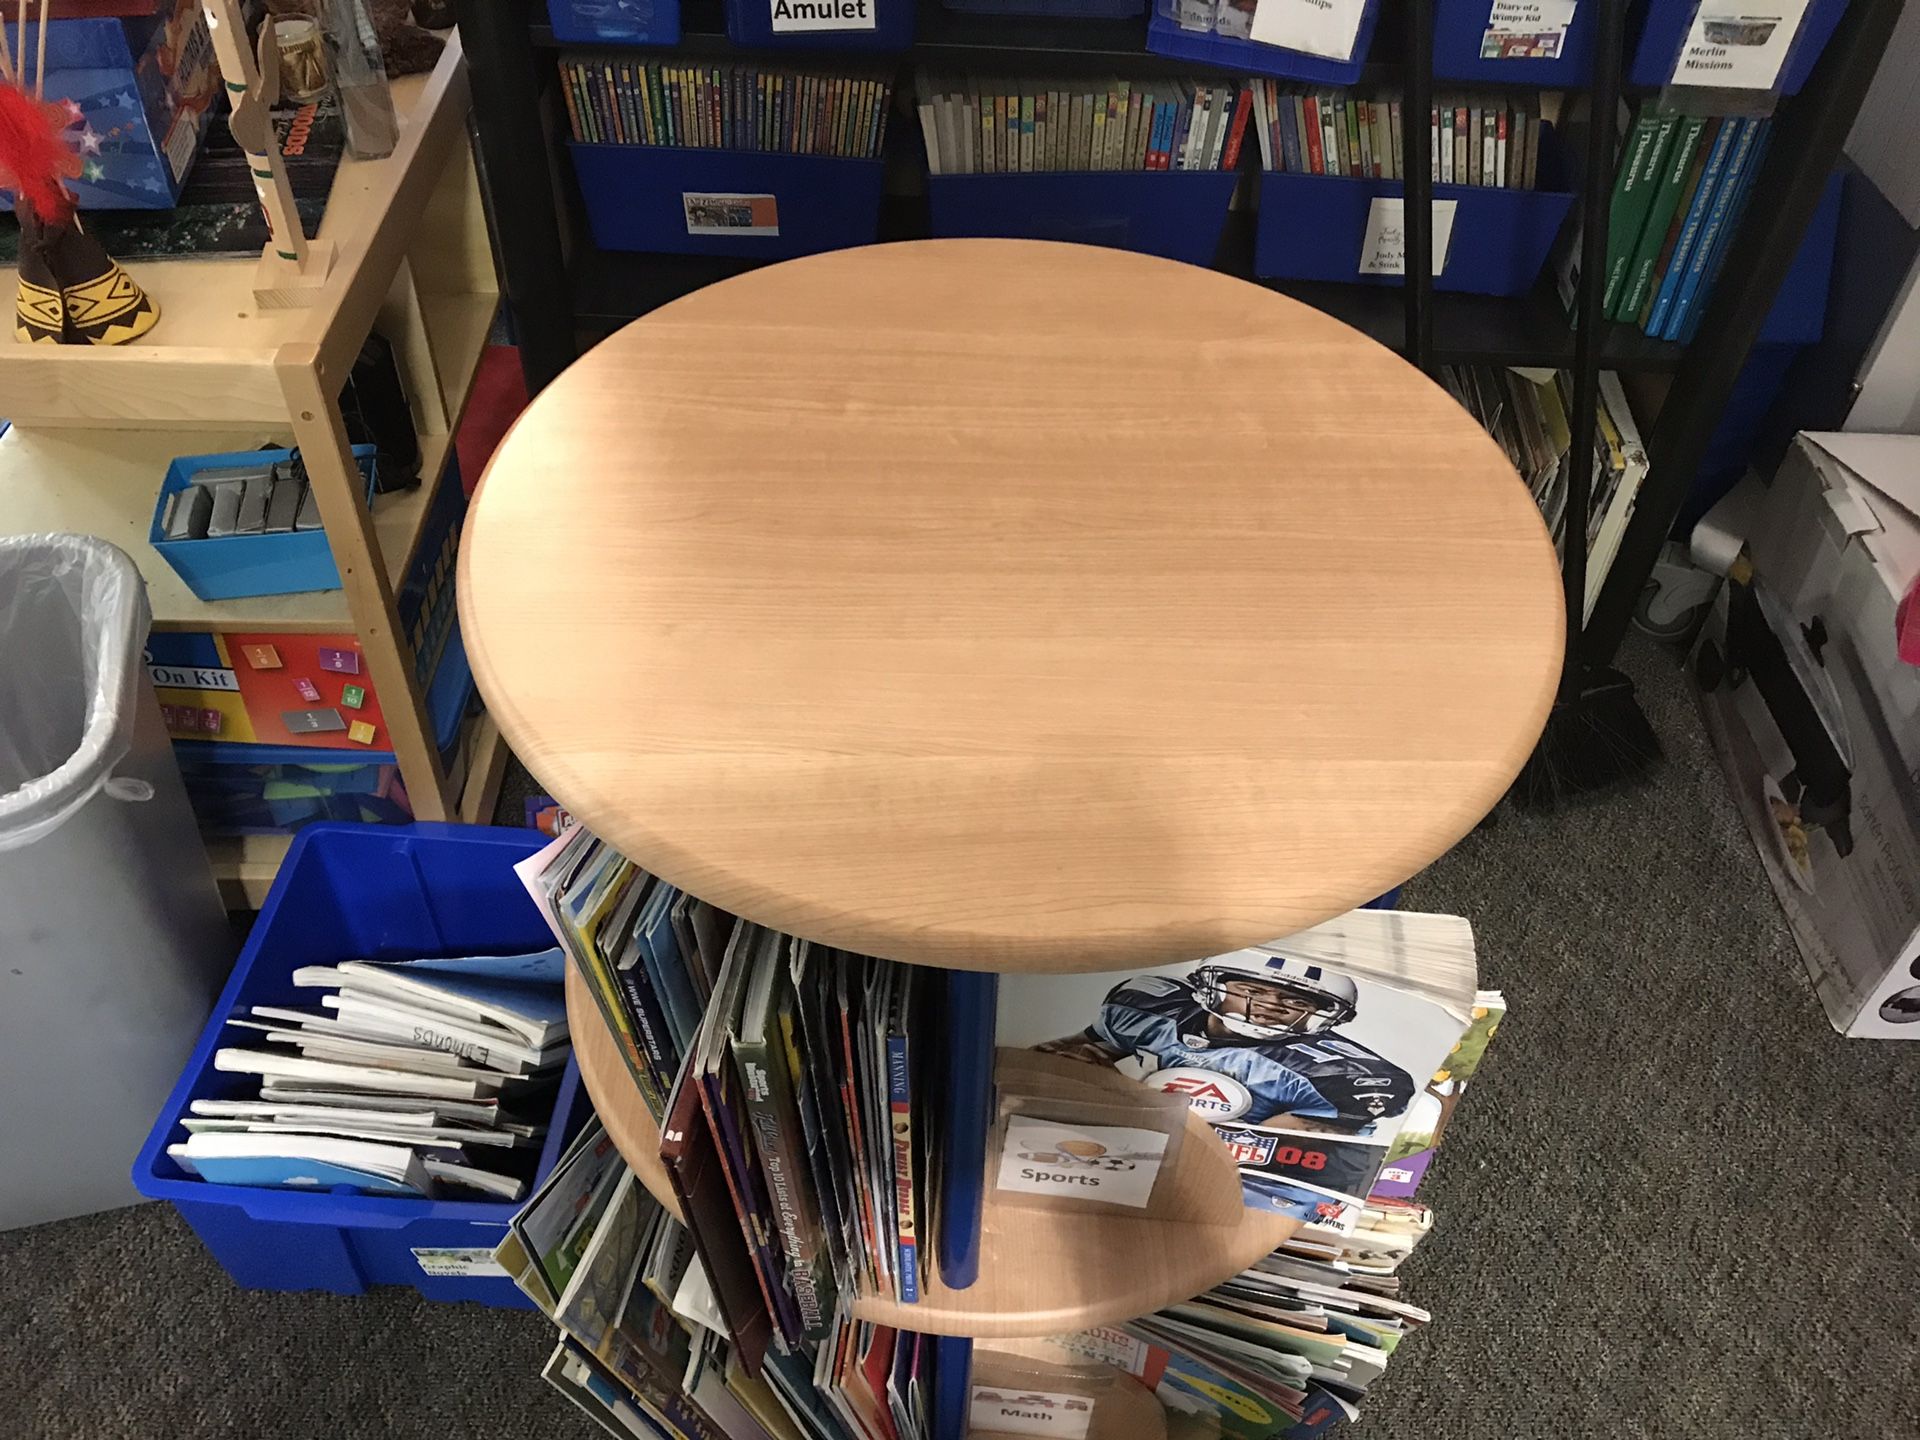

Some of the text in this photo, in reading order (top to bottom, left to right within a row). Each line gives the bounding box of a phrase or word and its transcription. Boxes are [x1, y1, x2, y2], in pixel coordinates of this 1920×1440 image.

[774, 0, 867, 19] Amulet
[1492, 13, 1523, 22] Wimpy
[1496, 2, 1521, 12] Diary
[1523, 3, 1533, 12] of
[1689, 46, 1727, 57] Merlin
[1684, 60, 1733, 70] Missions
[1624, 132, 1651, 192] Thesaurus
[1644, 122, 1671, 181] Thesaurus
[1672, 125, 1700, 184] Thesaurus
[152, 668, 229, 687] On Kit
[627, 985, 642, 1006] WWE
[636, 1007, 661, 1060] SUPERSTARS
[755, 1069, 769, 1096] Sports
[891, 1051, 905, 1094] MANNING
[1161, 1077, 1230, 1103] EA
[1275, 1146, 1328, 1171] 08
[1021, 1168, 1100, 1187] Sports
[768, 1156, 780, 1173] Top
[779, 1212, 805, 1263] Everything
[792, 1268, 823, 1332] BASEBALL
[1001, 1408, 1053, 1421] Math
